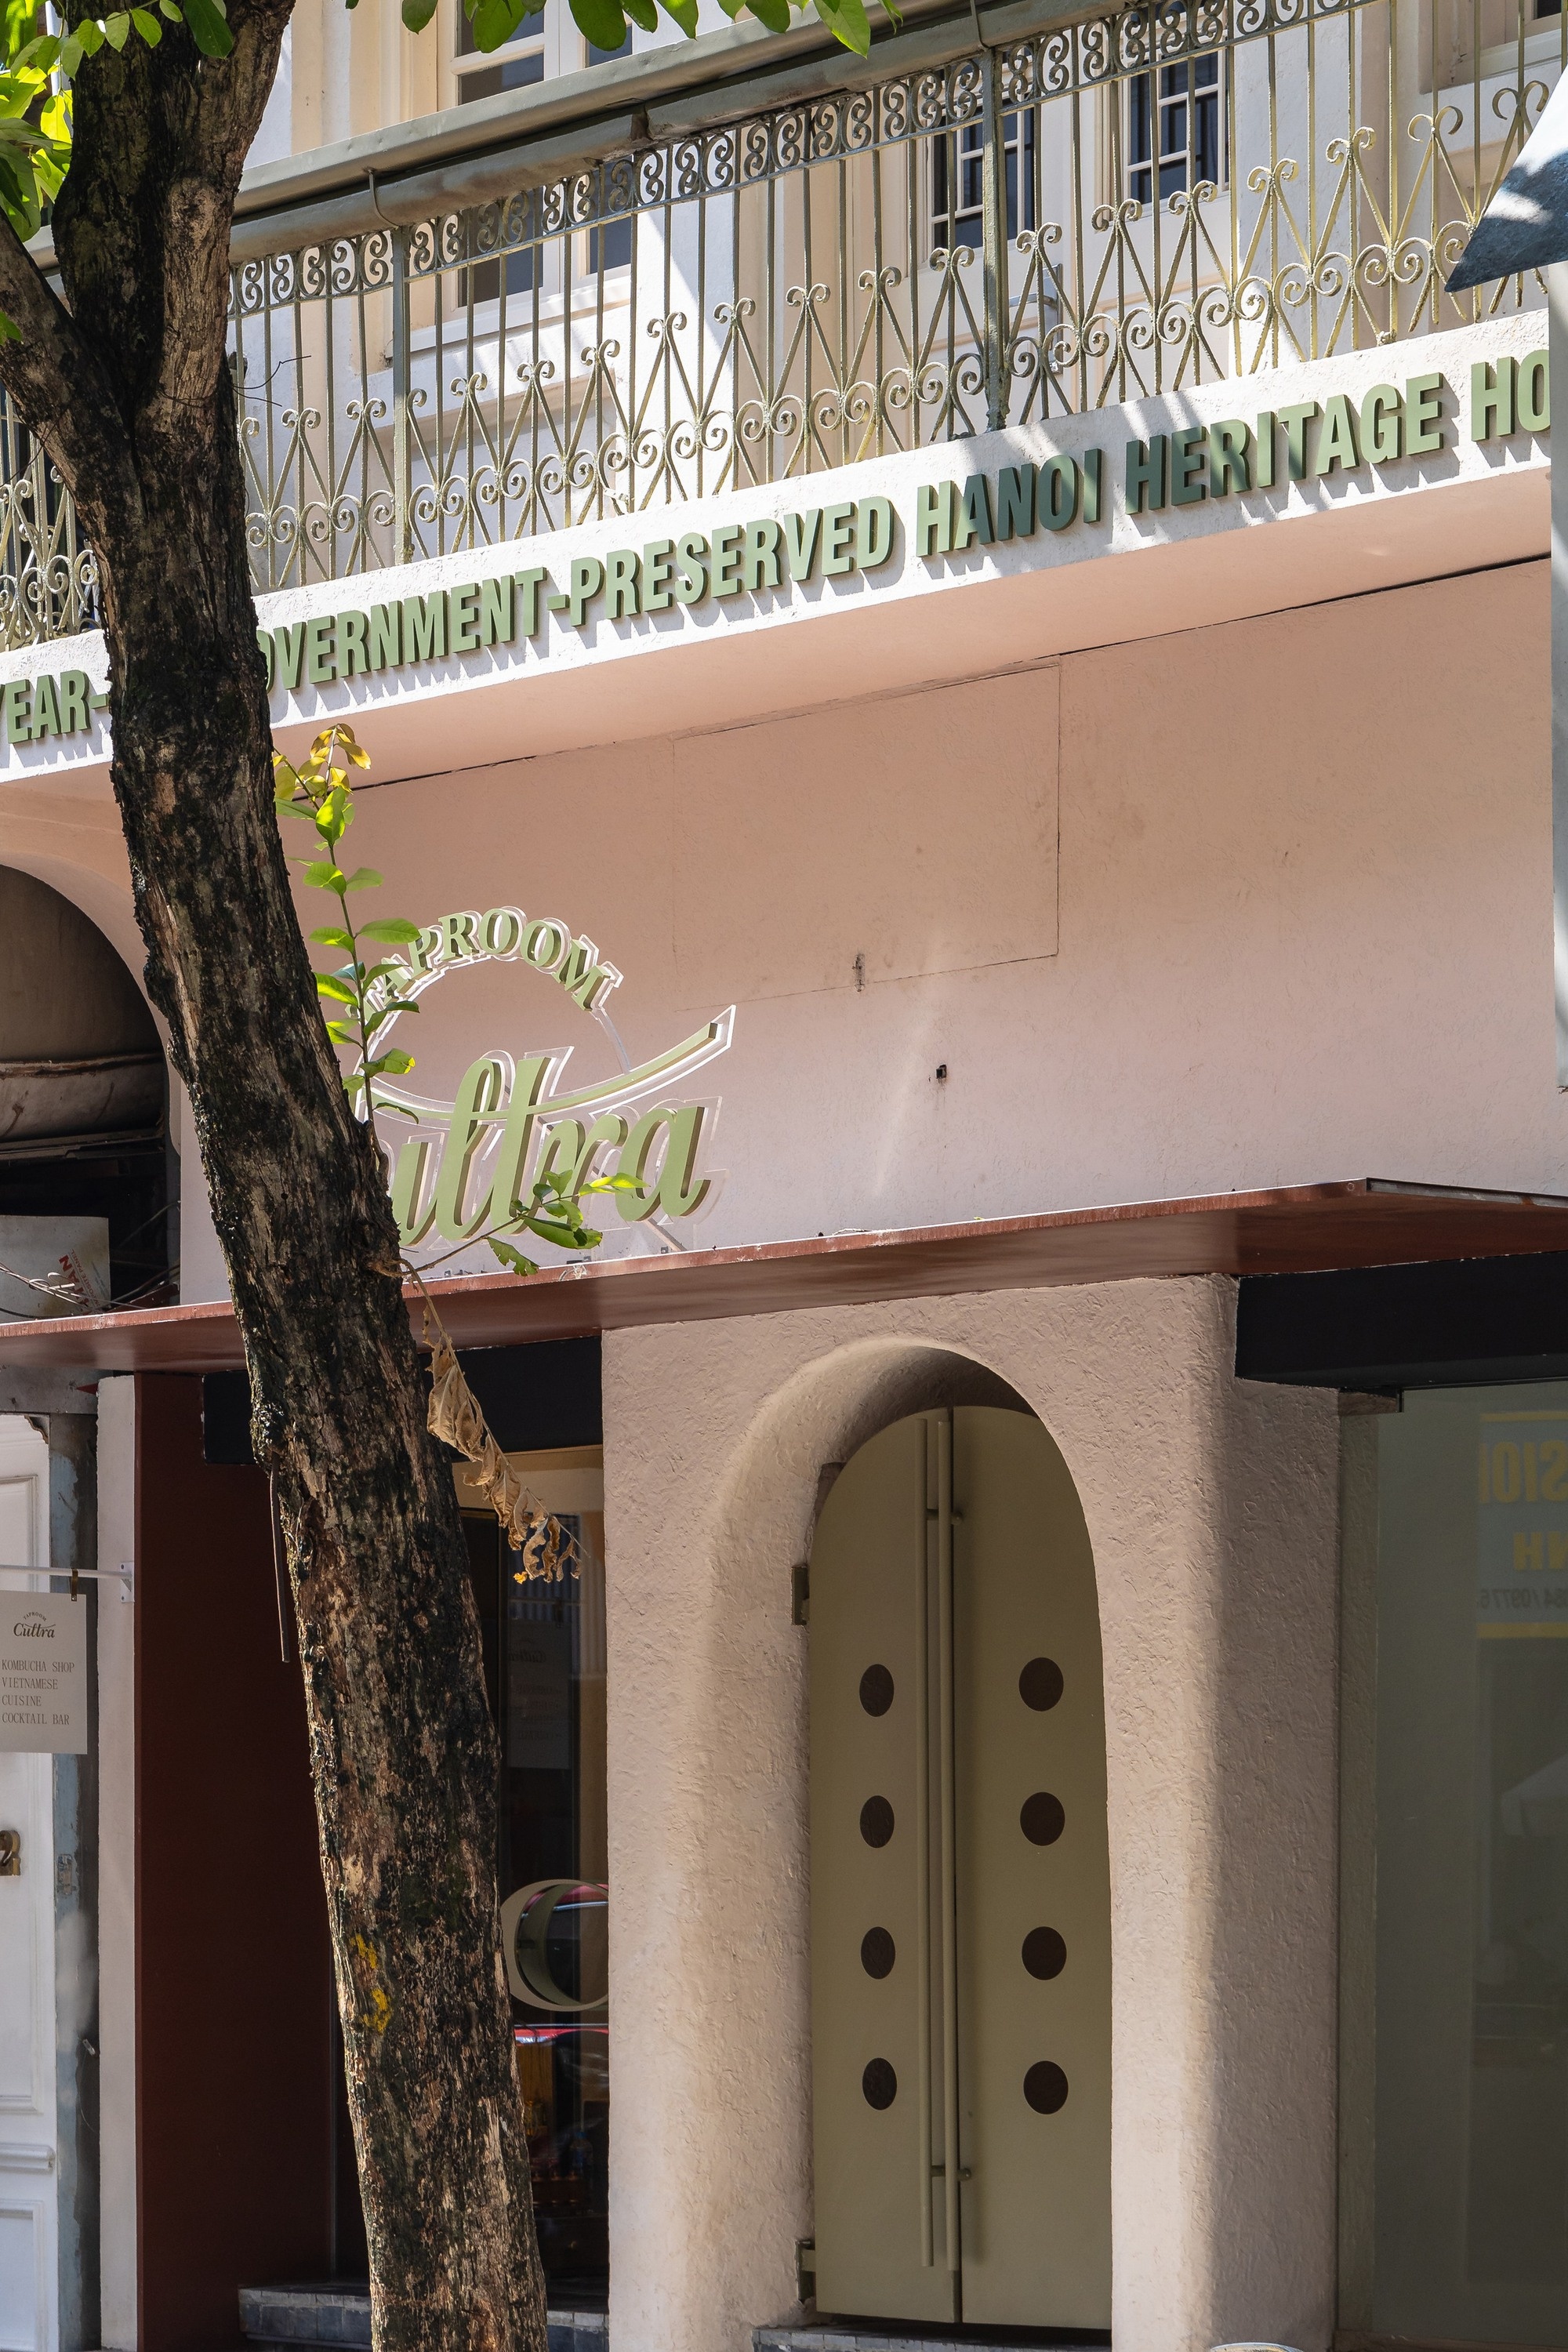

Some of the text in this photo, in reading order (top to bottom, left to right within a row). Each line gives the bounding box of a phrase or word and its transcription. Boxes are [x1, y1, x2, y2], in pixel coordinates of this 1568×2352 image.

[0, 669, 108, 744] EAR-
[917, 448, 1102, 557] HANOI
[1125, 372, 1444, 515] HERITAGE
[13, 1622, 56, 1639] Cultra
[2, 1659, 74, 1673] KOMBUCHA SHOP
[2, 1677, 59, 1690] VIETNAMESE
[2, 1694, 42, 1707] CUISINE
[2, 1712, 70, 1726] COCKTAIL BAR
